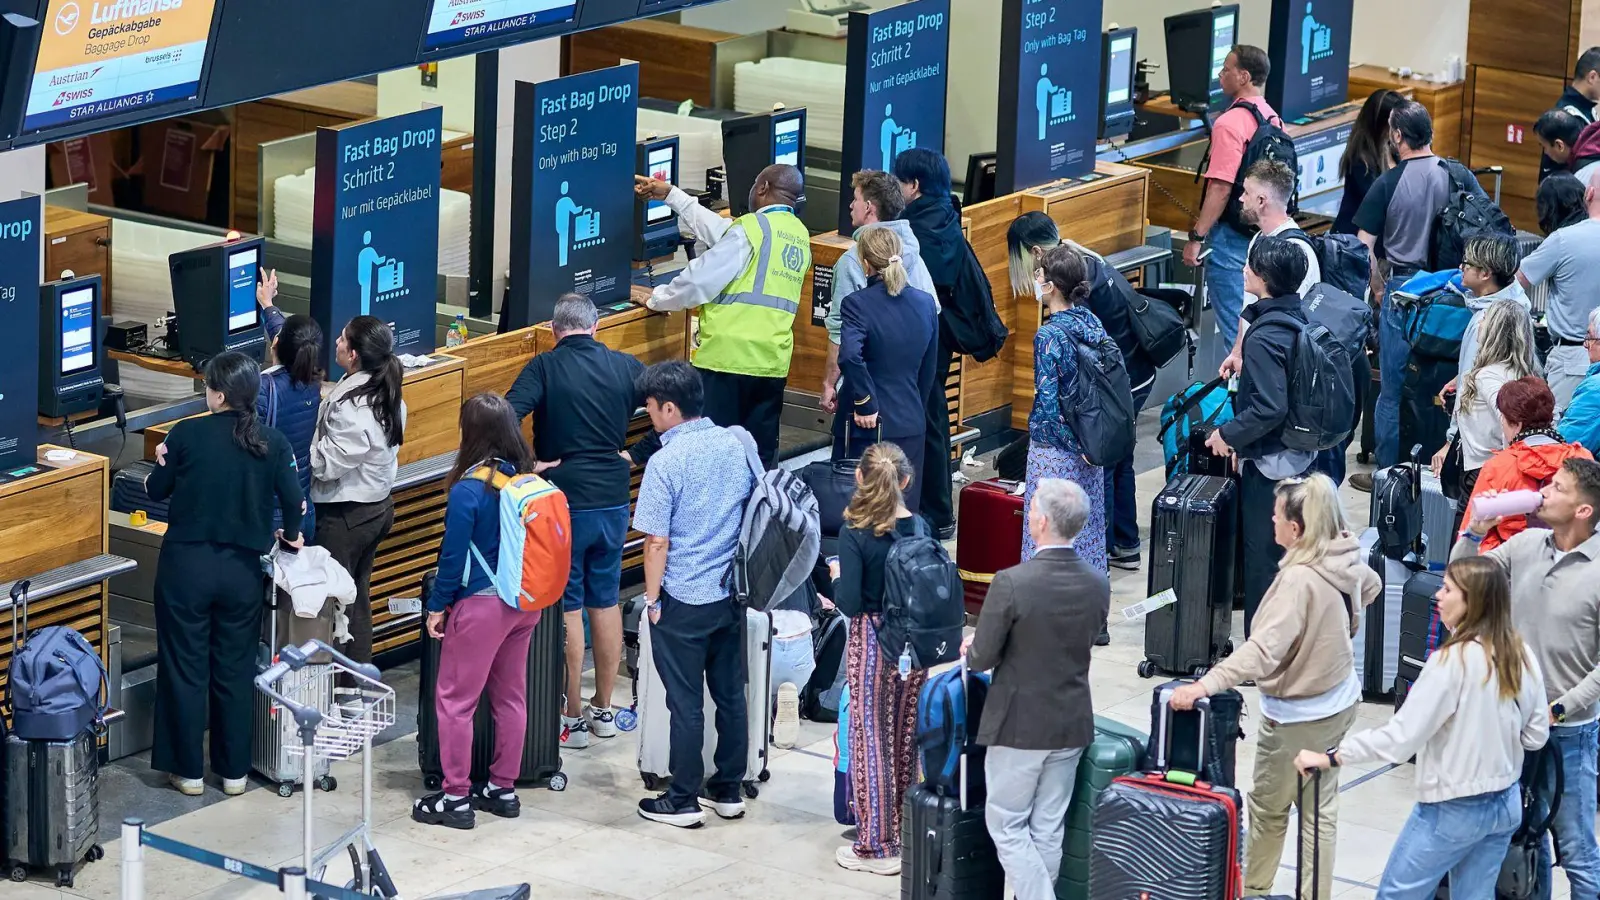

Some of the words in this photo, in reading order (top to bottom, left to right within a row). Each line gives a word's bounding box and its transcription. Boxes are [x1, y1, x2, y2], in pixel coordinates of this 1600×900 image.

[462, 9, 485, 22] SWISS
[464, 24, 485, 37] STAR
[486, 16, 527, 33] ALLIANCE
[872, 22, 893, 44] Fast
[894, 19, 914, 38] Bag
[917, 12, 943, 31] Drop
[1025, 12, 1047, 29] Step
[1049, 7, 1056, 23] 2
[88, 17, 161, 40] Gepäckabgabe
[84, 38, 126, 55] Baggage
[127, 33, 150, 46] Drop
[1024, 38, 1040, 54] Only
[1041, 35, 1056, 48] with
[1058, 32, 1071, 45] Bag
[1073, 29, 1087, 42] Tag
[871, 44, 902, 69] Schritt
[904, 42, 911, 58] 2
[49, 69, 89, 87] Austrian
[869, 81, 882, 94] Nur
[883, 74, 895, 89] mit
[896, 62, 940, 86] Gepäcklabel
[65, 88, 94, 102] SWISS
[69, 105, 94, 119] STAR
[96, 95, 143, 113] ALLIANCE
[541, 93, 567, 116] Fast
[570, 90, 595, 111] Bag
[599, 83, 631, 103] Drop
[540, 123, 566, 143] Step
[570, 118, 578, 135] 2
[344, 139, 370, 164] Fast
[373, 136, 398, 157] Bag
[402, 128, 436, 149] Drop
[539, 153, 558, 171] Only
[560, 149, 579, 164] with
[581, 146, 598, 161] Bag
[600, 142, 617, 157] Tag
[342, 164, 384, 192] Schritt
[386, 161, 395, 180] 2
[341, 204, 358, 220] Nur
[359, 197, 374, 213] mit
[376, 184, 432, 211] Gepäcklabel
[224, 857, 243, 874] BER
